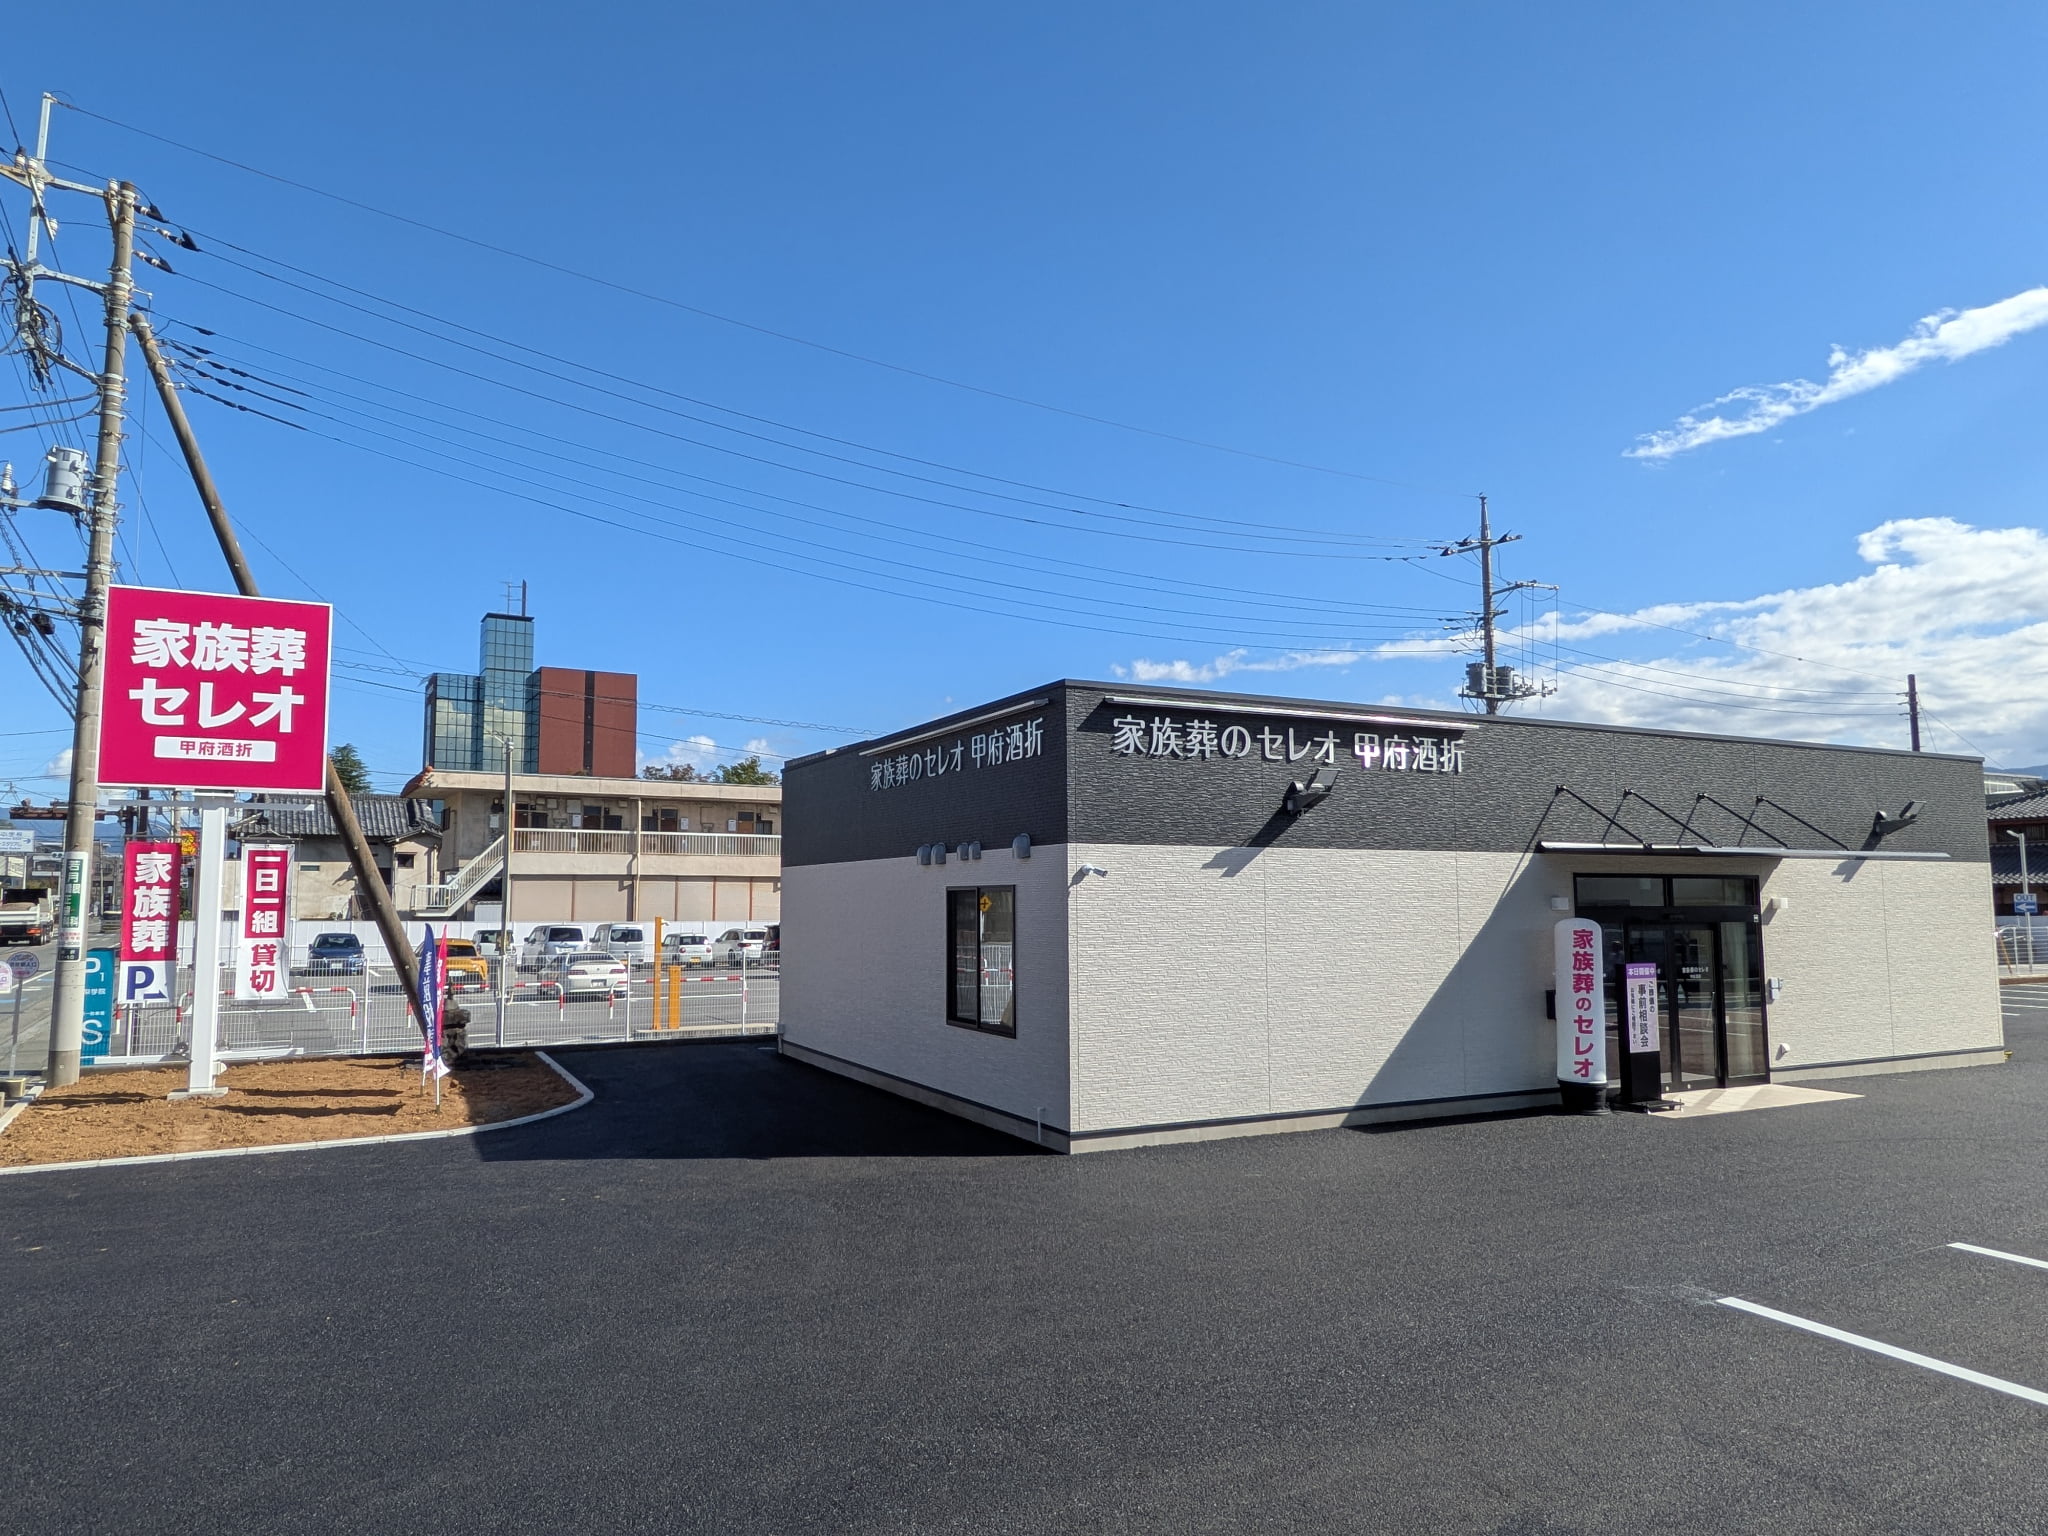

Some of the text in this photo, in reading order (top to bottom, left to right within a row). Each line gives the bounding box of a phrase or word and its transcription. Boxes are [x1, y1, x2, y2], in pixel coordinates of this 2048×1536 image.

[130, 618, 307, 676] 家族葬
[128, 677, 305, 733] セレオ
[180, 740, 253, 758] 甲府酒折
[870, 717, 1044, 792] 家族葬のセレオ 甲府酒折
[1111, 714, 1466, 774] 家族葬のセレオ 甲府酒折
[131, 851, 172, 953] 家族葬
[251, 855, 281, 934] 一日一組
[2015, 894, 2034, 902] OUT
[126, 965, 155, 1000] P
[249, 943, 278, 993] 貸切
[1572, 928, 1595, 1078] 家族葬のセレオ
[1637, 983, 1649, 1048] 事前相談会
